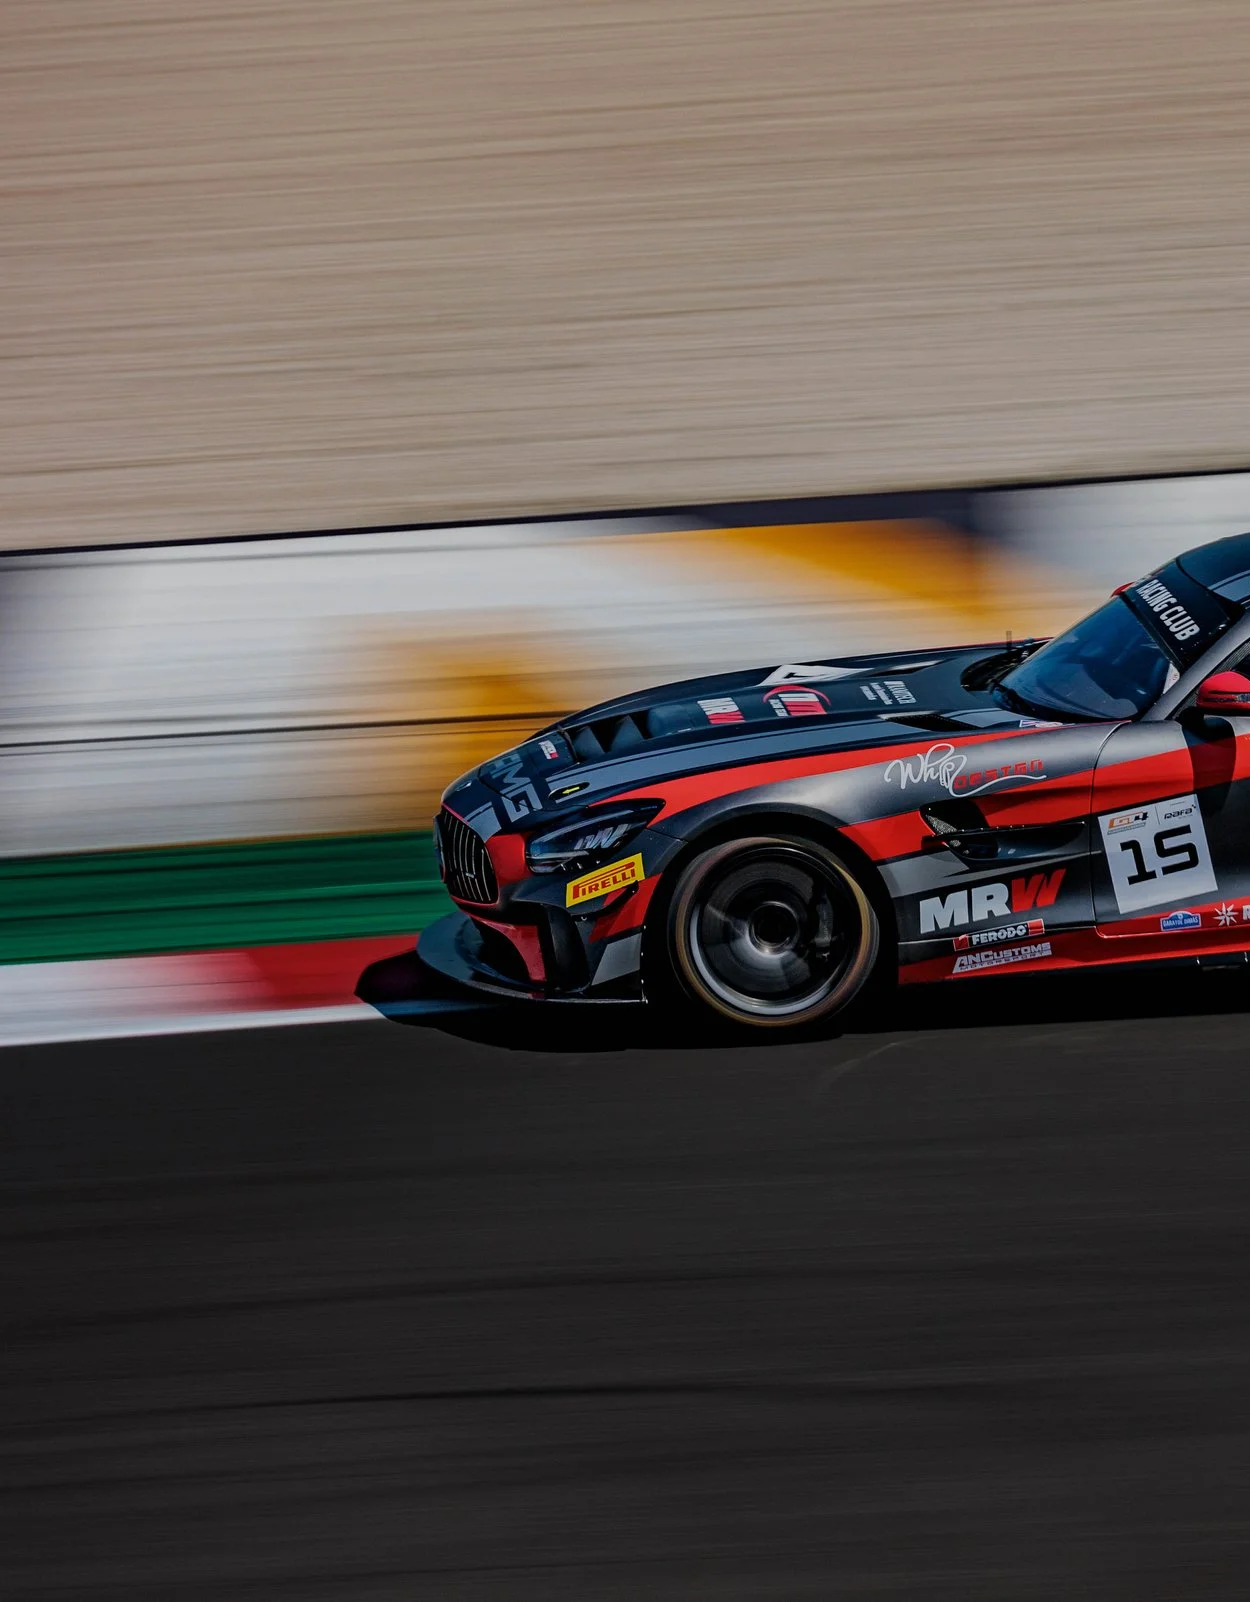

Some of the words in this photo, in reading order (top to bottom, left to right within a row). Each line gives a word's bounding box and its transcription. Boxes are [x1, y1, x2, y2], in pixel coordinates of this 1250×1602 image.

[1135, 579, 1178, 613] RACING
[1159, 605, 1201, 641] CLUB
[572, 861, 637, 900] PIRELLI
[1119, 823, 1200, 886] 15
[919, 868, 1067, 935] MRW
[971, 924, 1027, 946] FERODO
